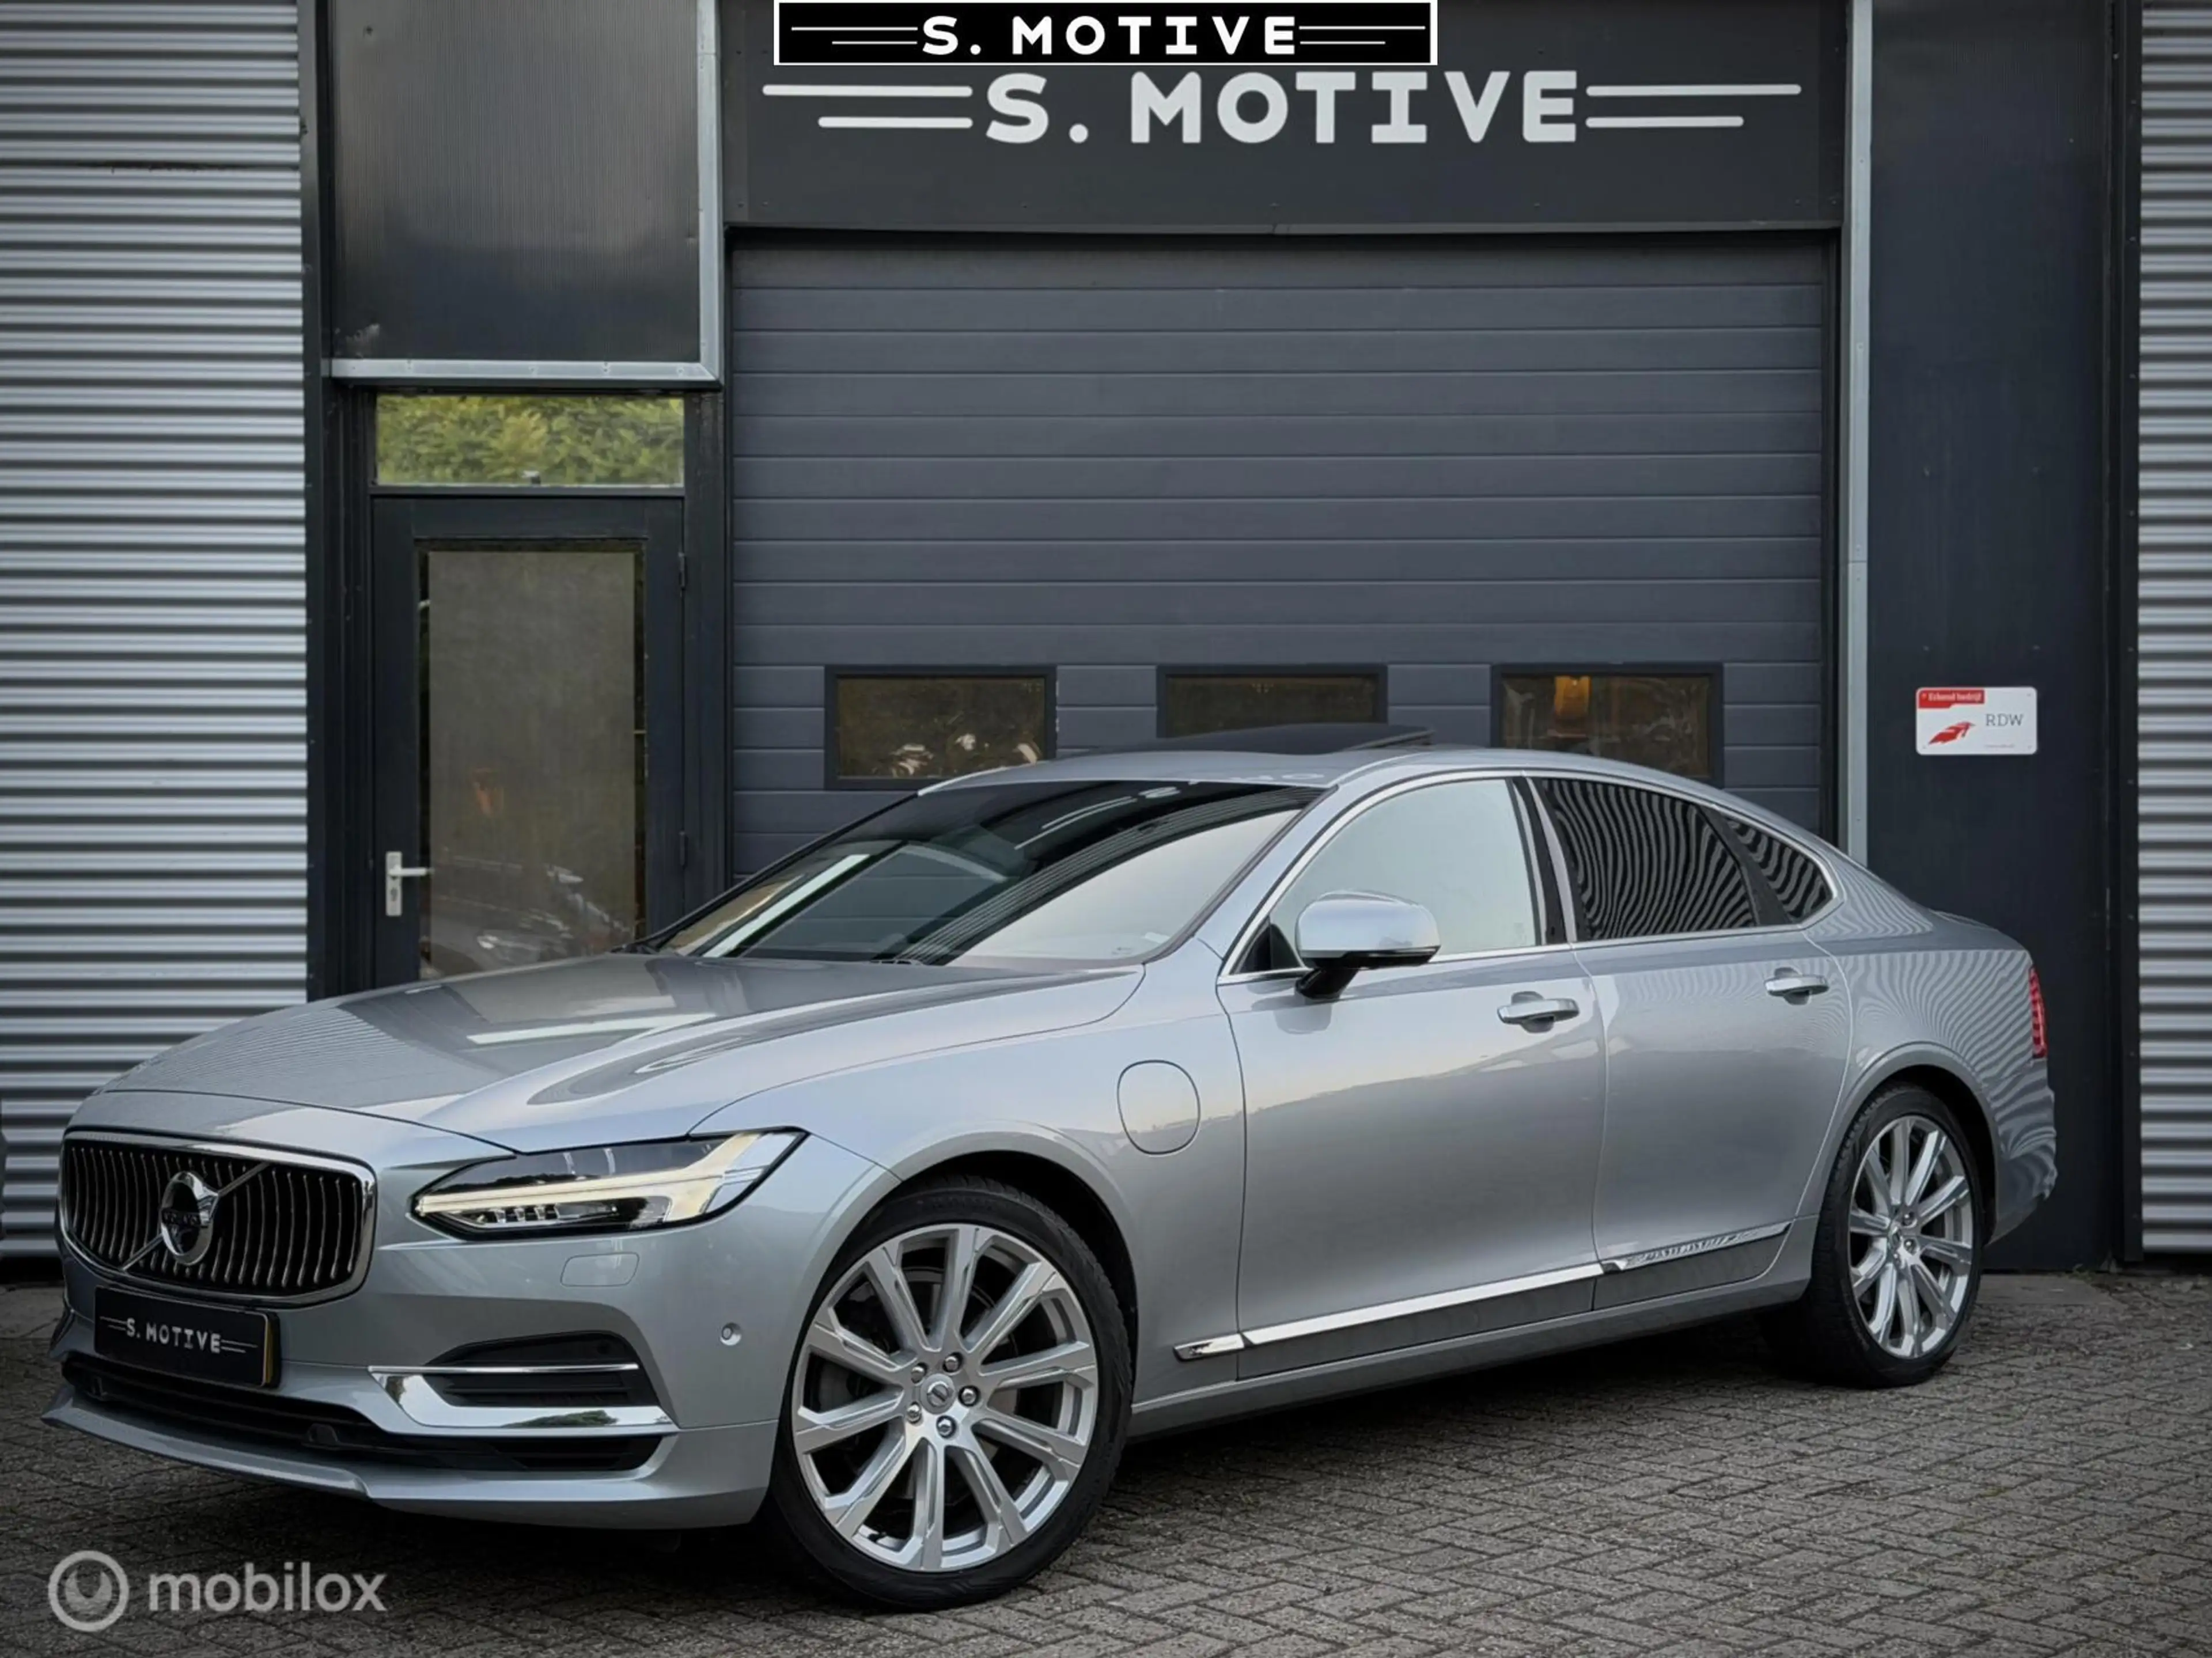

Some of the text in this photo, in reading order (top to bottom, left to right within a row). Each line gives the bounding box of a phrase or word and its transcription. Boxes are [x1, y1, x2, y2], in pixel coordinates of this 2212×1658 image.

[986, 71, 1577, 143] S. MOTIVE
[1985, 713, 2024, 726] RDW
[127, 1318, 221, 1354] S. MOTIVE
